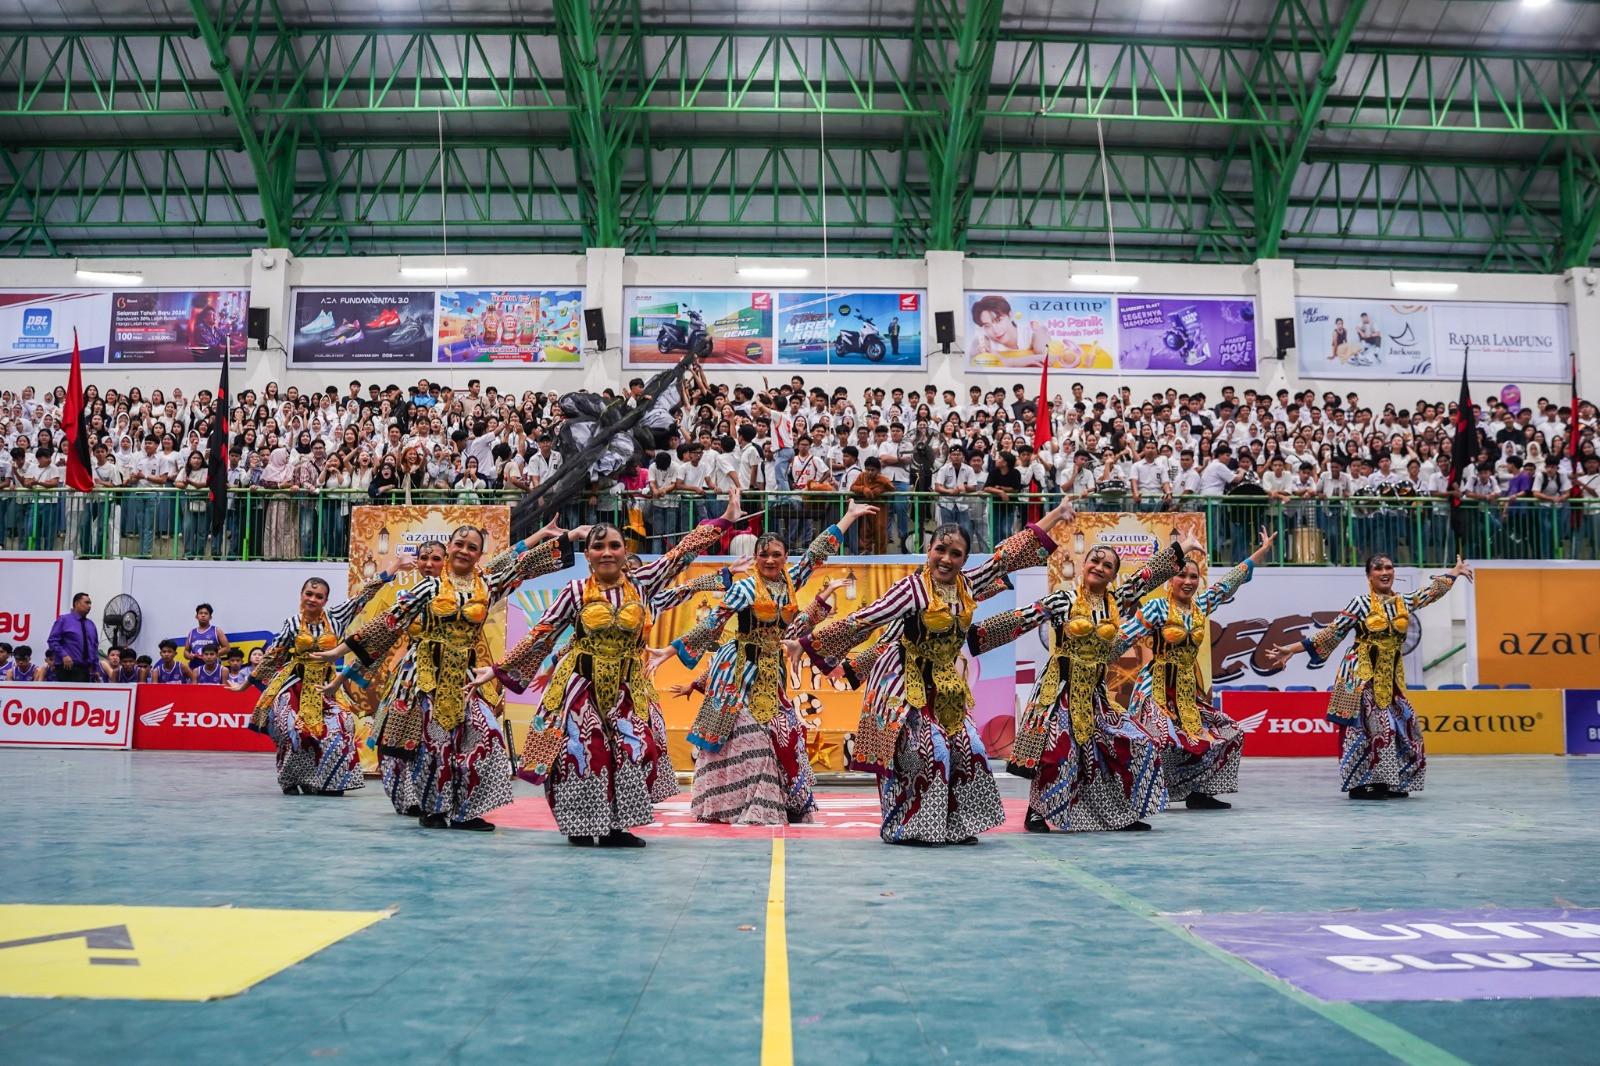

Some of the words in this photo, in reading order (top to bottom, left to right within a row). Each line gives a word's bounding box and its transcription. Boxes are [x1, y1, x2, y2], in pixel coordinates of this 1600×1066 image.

[1029, 300, 1103, 312] azarine
[26, 315, 49, 326] DBL
[1047, 319, 1065, 328] No
[1067, 315, 1103, 328] Panik
[1122, 309, 1163, 321] SEGERNYA
[723, 328, 760, 338] BENER
[784, 318, 837, 333] KEREN
[1449, 332, 1490, 346] RADAR
[1492, 333, 1553, 347] LAMPUNG
[1219, 341, 1253, 354] MOVE
[1389, 347, 1421, 355] Jackson
[1114, 545, 1152, 560] DANCE
[1499, 632, 1600, 656] azar
[70, 700, 121, 735] Day
[173, 712, 253, 729] HON
[1268, 718, 1340, 734] HON
[1326, 952, 1600, 972] BLUE
